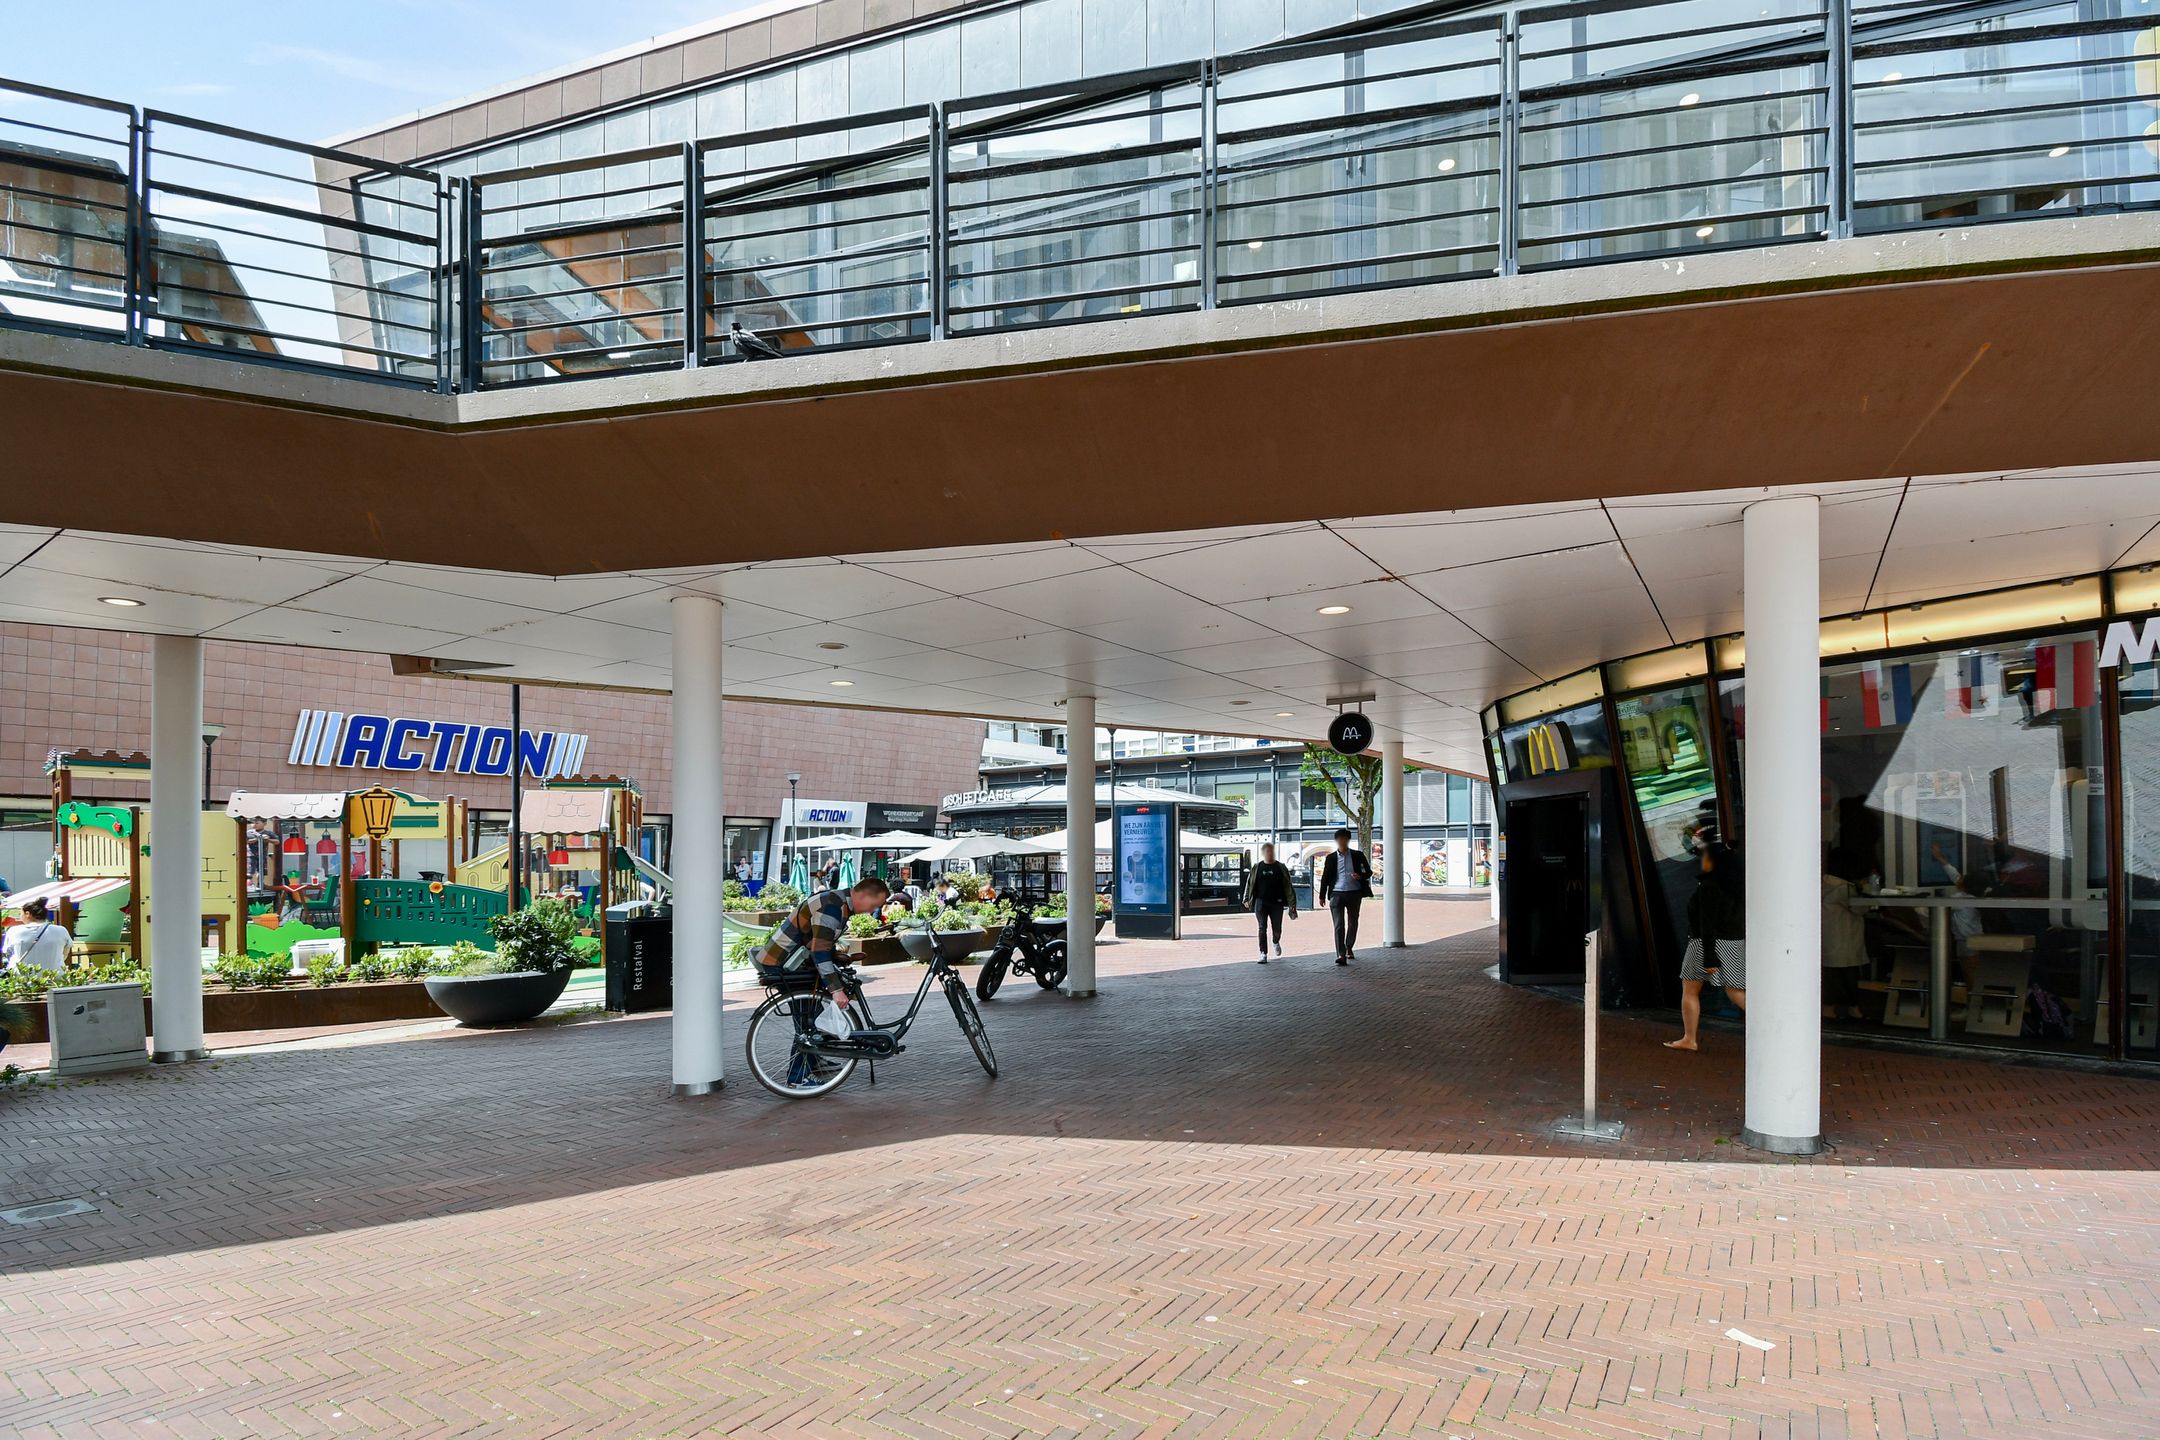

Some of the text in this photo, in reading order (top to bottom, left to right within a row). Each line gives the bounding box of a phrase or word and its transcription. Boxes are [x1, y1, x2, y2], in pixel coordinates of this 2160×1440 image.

[336, 712, 555, 779] ACTION
[808, 809, 847, 823] ACTION
[633, 940, 643, 991] Restafval
